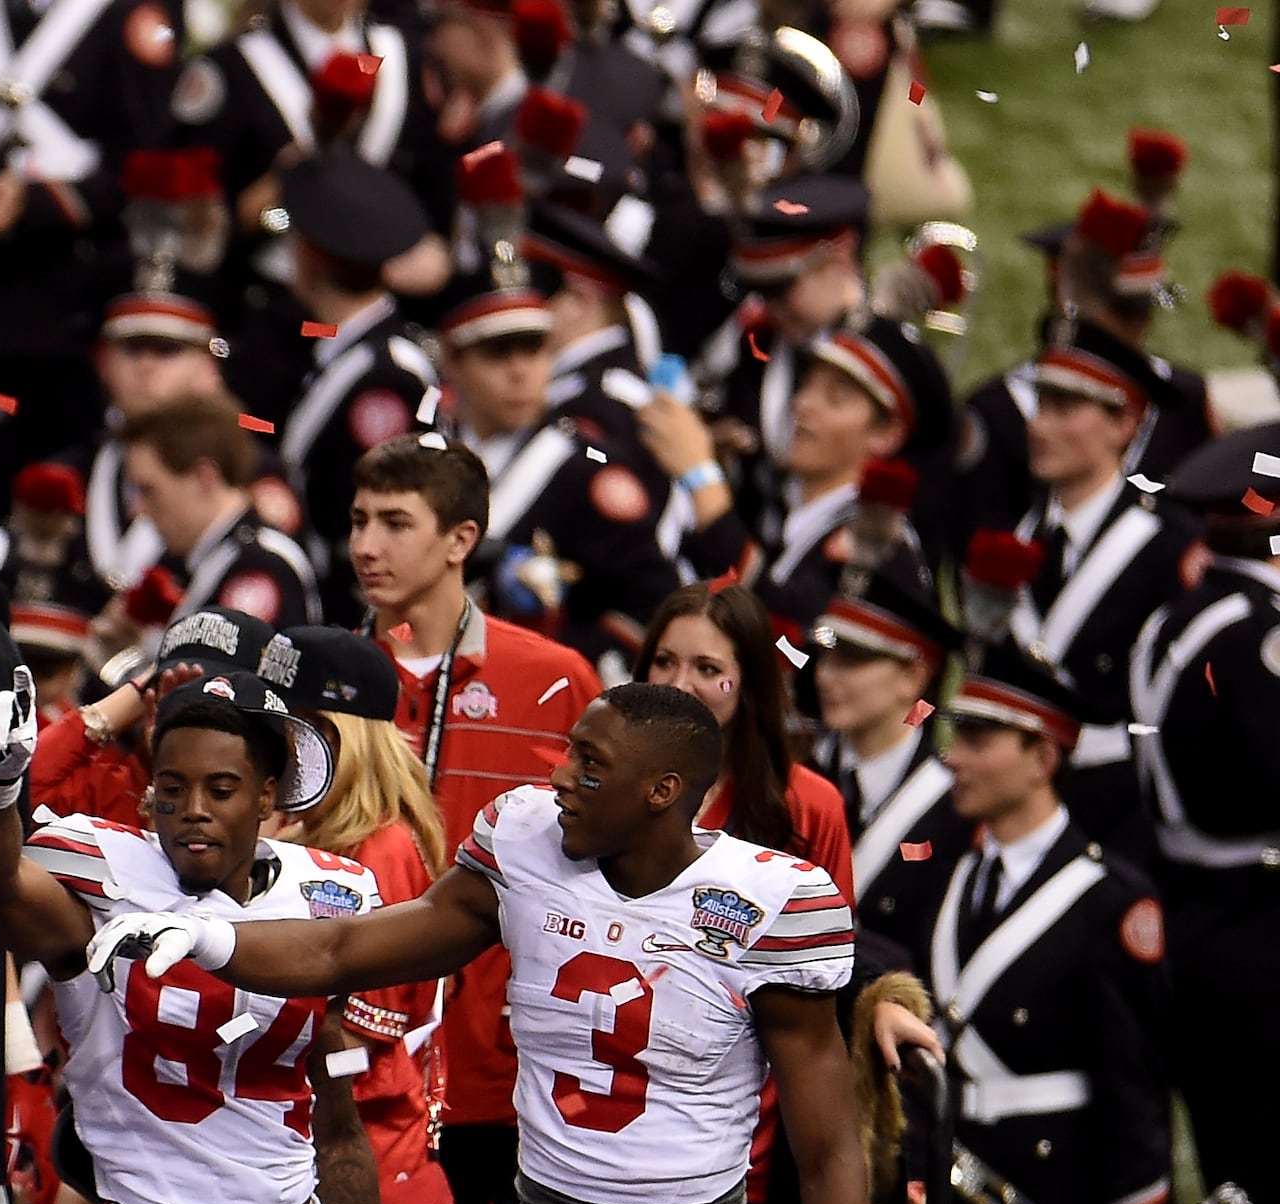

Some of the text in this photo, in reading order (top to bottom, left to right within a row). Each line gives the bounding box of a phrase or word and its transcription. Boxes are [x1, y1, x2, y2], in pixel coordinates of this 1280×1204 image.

[311, 890, 354, 908] Allstate
[703, 898, 751, 924] Allstate
[122, 955, 329, 1141] 84
[550, 950, 655, 1134] 3
